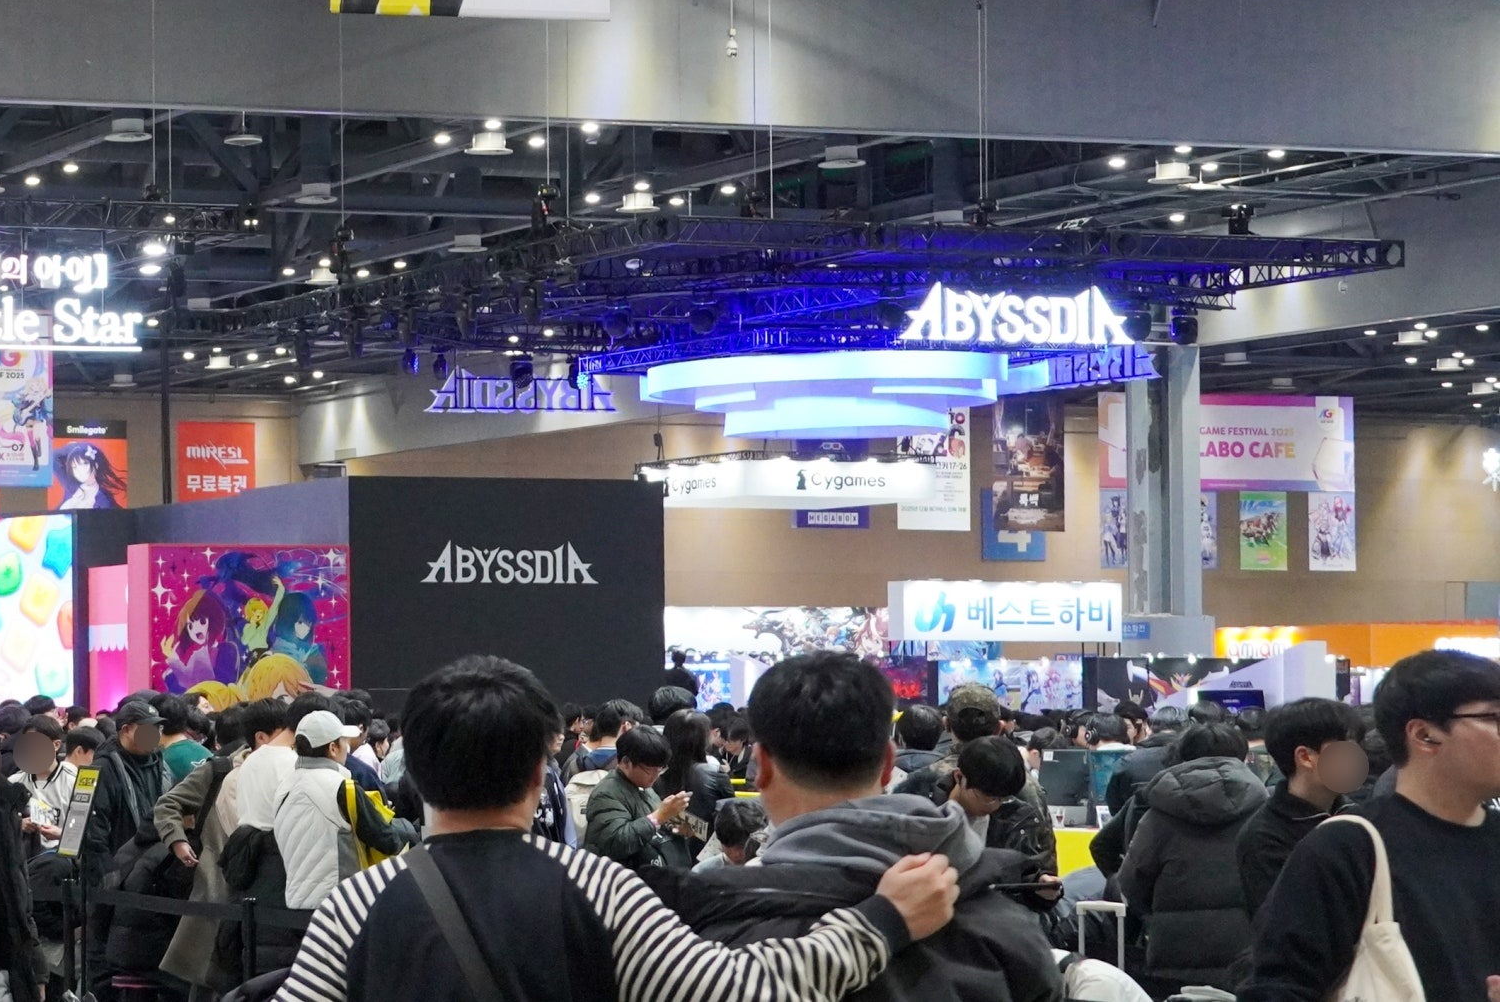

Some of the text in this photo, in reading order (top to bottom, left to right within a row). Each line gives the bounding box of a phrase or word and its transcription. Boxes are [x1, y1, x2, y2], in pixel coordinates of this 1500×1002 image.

[53, 298, 143, 344] Star
[899, 281, 1135, 345] ABYSSDIA
[66, 425, 106, 436] Smilegate
[1200, 427, 1225, 436] GAME
[1228, 427, 1268, 436] FESTIVAL
[11, 443, 25, 452] 07
[1249, 441, 1296, 459] CAFE
[672, 476, 717, 495] Cygames
[811, 472, 886, 490] Cygames
[808, 512, 859, 525] MEGABOX
[420, 540, 598, 584] ABYSSDIA
[967, 594, 1113, 633] 베스트하비
[1228, 642, 1285, 657] amiam
